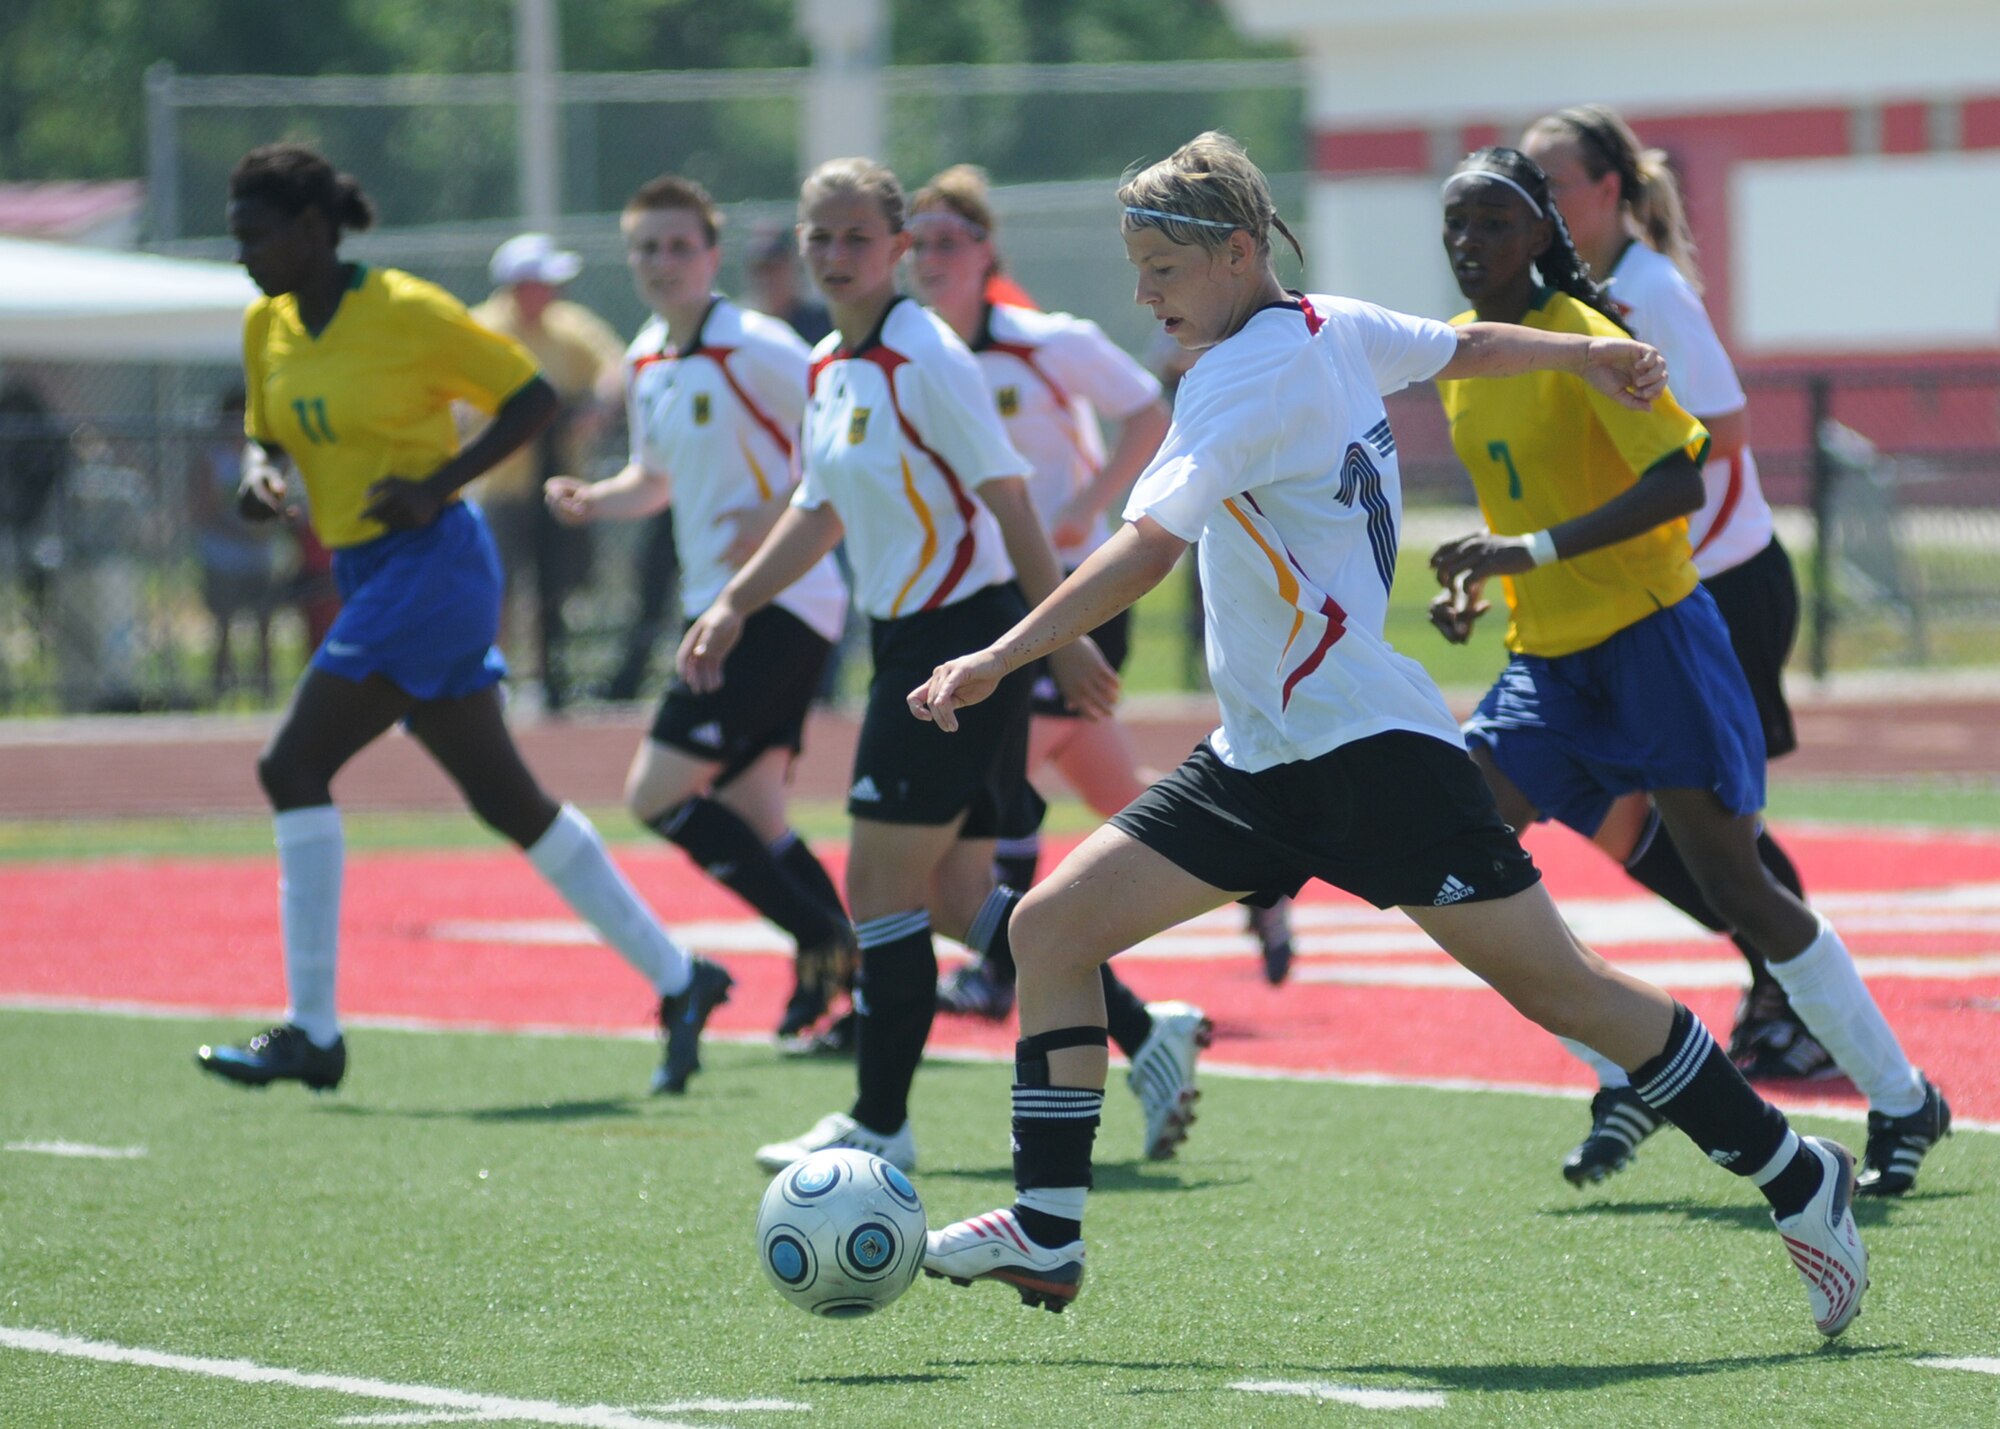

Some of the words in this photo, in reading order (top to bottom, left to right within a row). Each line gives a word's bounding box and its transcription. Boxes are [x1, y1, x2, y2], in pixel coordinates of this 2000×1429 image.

[292, 397, 338, 445] 11
[1486, 440, 1523, 501] 7
[1433, 885, 1475, 907] adidas
